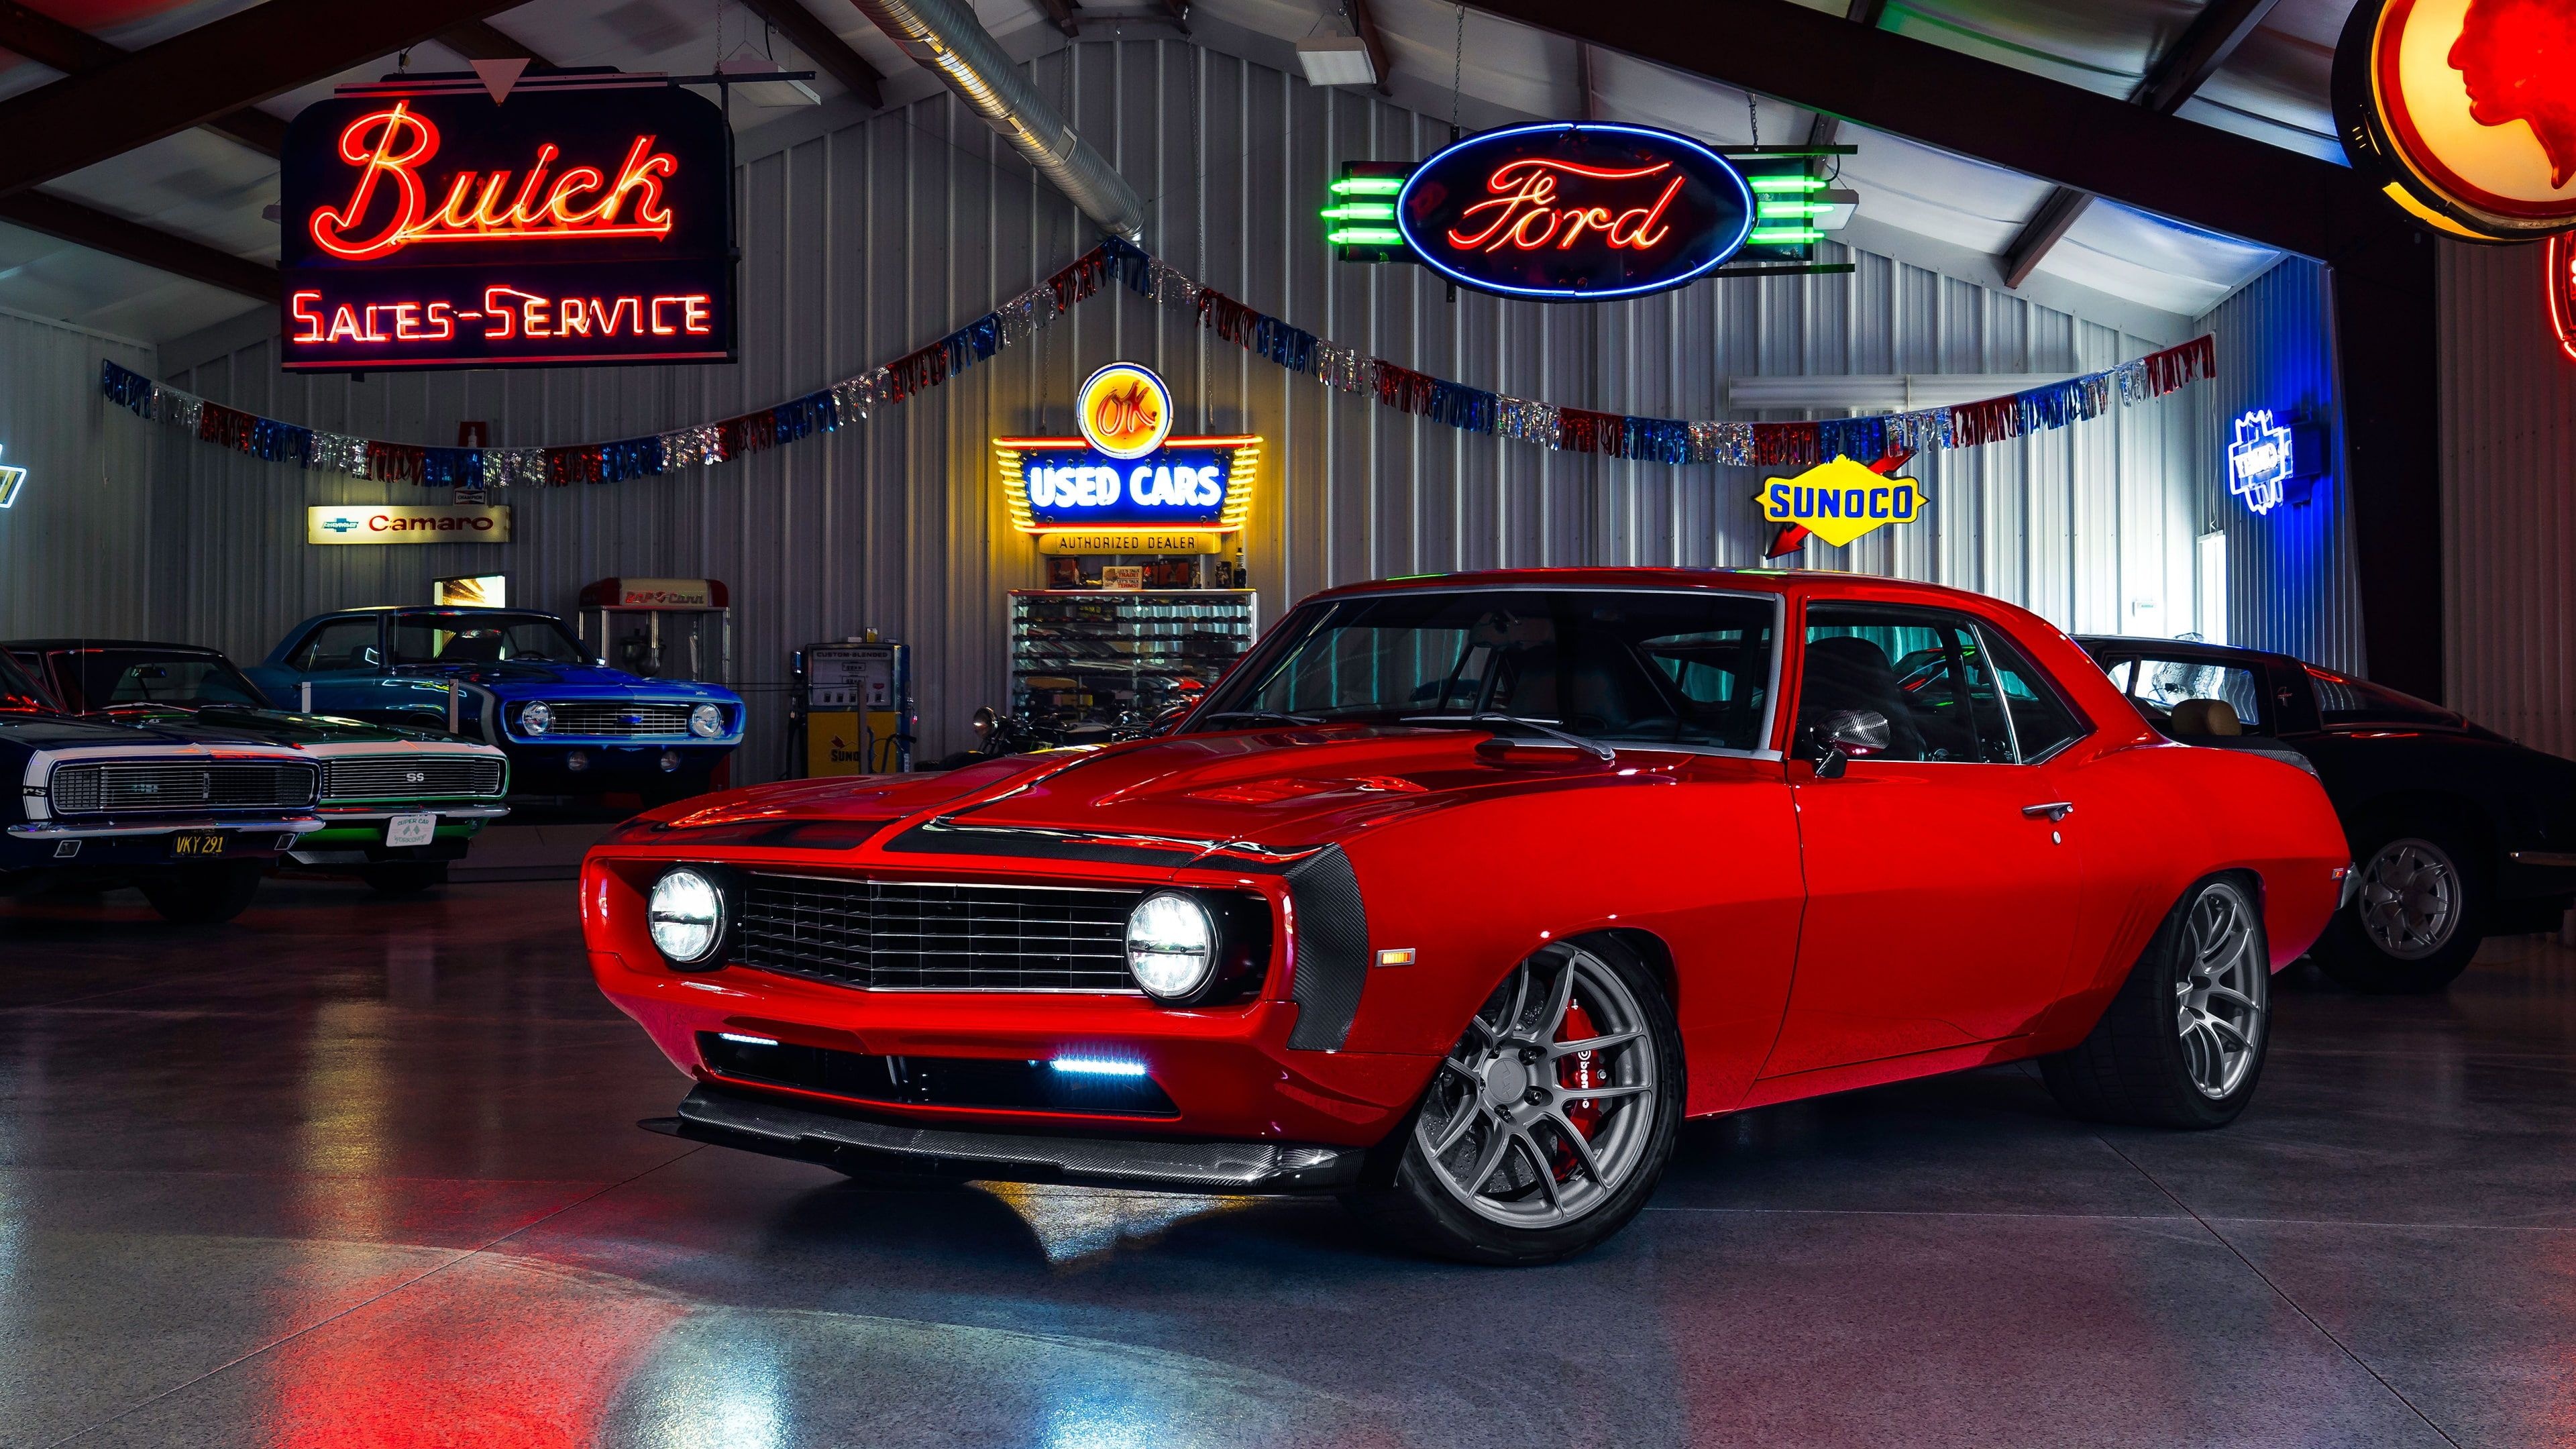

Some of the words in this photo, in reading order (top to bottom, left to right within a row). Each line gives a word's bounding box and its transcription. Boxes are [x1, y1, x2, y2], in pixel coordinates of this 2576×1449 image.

[309, 99, 678, 260] Buick
[1448, 158, 1685, 253] Ford
[1096, 380, 1155, 436] OK
[1030, 466, 1120, 508] USED
[1129, 466, 1222, 506] CARS
[1770, 484, 1913, 519] SUNOCO
[369, 515, 494, 531] Camaro
[1059, 537, 1139, 549] AUTHORIZED
[1148, 537, 1195, 549] DEALER
[832, 749, 859, 762] SUNO
[406, 773, 424, 782] SS
[176, 836, 201, 854] VKY
[201, 836, 223, 854] 291
